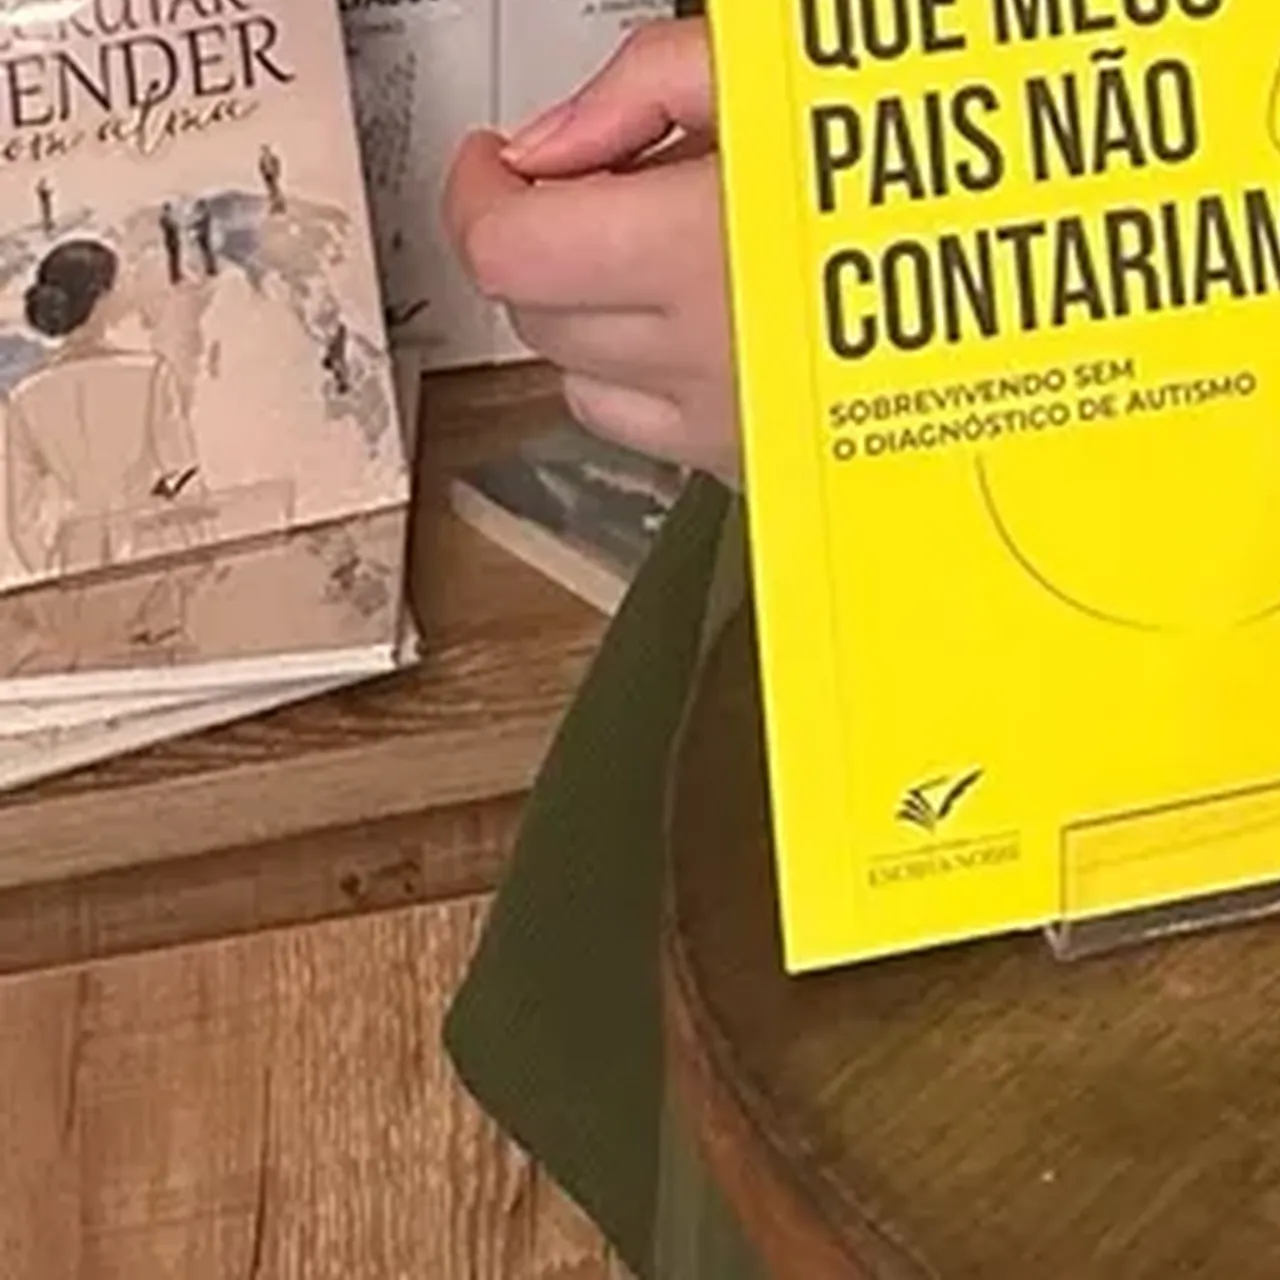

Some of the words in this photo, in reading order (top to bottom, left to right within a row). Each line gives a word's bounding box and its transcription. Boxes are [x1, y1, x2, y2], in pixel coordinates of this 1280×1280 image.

[1, 14, 297, 129] ENDER
[810, 84, 1005, 214] PAIS
[1025, 46, 1199, 183] NÃO
[829, 366, 1068, 427] SOBREVIVENDO
[1073, 359, 1137, 392] SEM
[832, 438, 857, 462] O
[865, 402, 1070, 458] DIAGNÓSTICO
[1077, 394, 1121, 425] DE
[1123, 371, 1257, 417] AUTISMO
